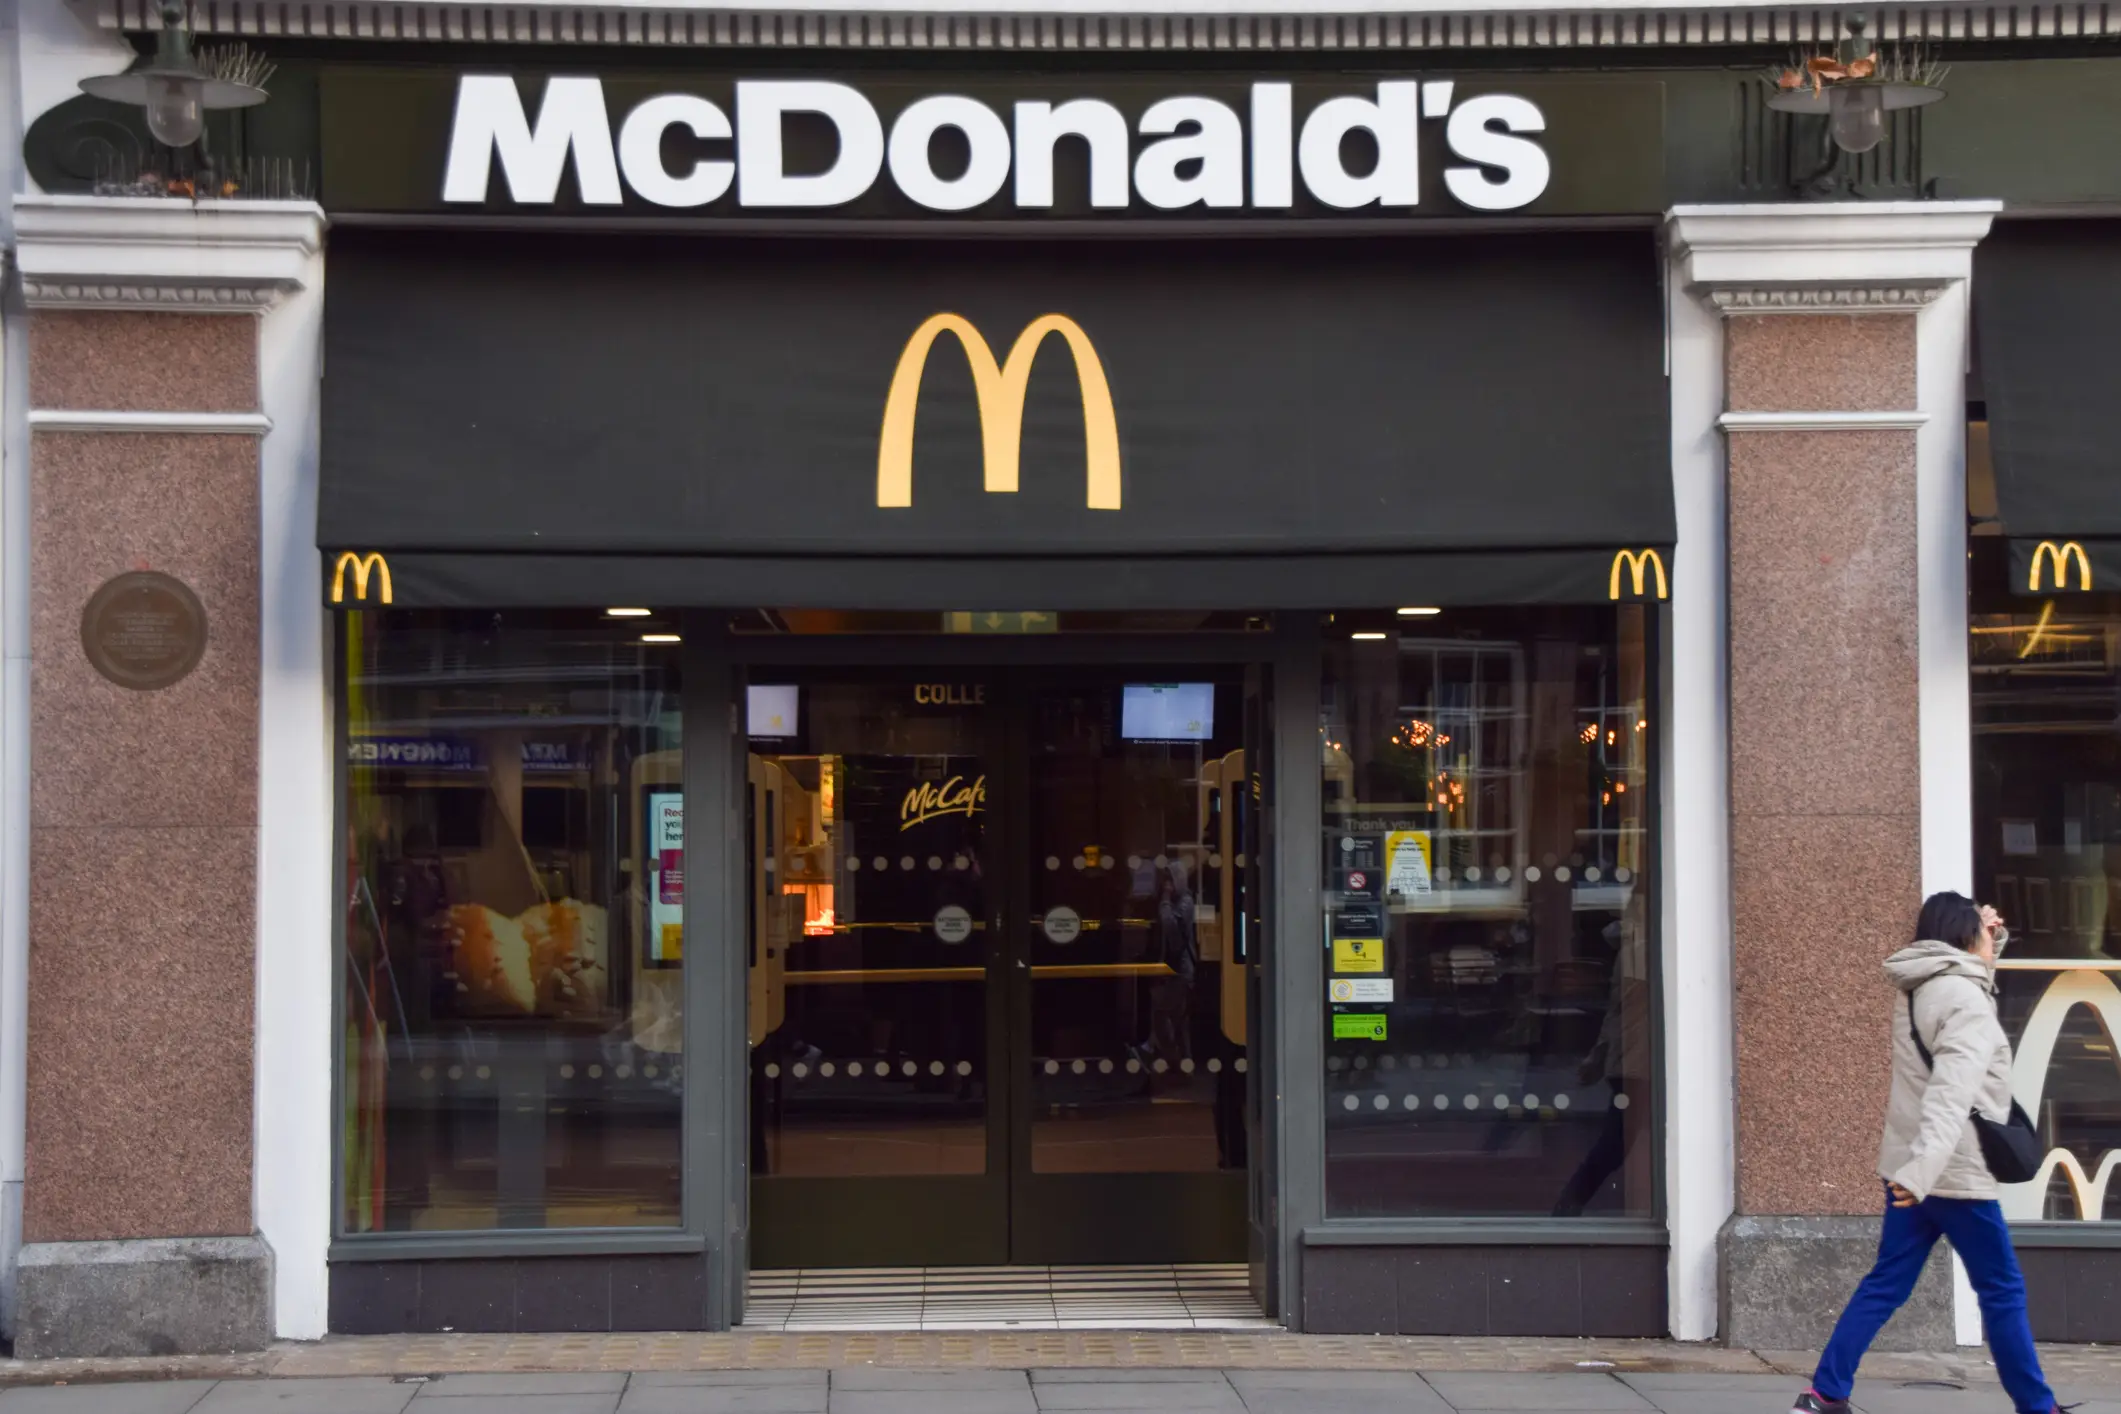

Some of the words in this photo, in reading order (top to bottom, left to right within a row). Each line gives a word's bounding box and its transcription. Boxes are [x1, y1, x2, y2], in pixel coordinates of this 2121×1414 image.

[443, 75, 1550, 210] McDonald's
[1344, 817, 1387, 830] Thank
[1391, 819, 1416, 832] you
